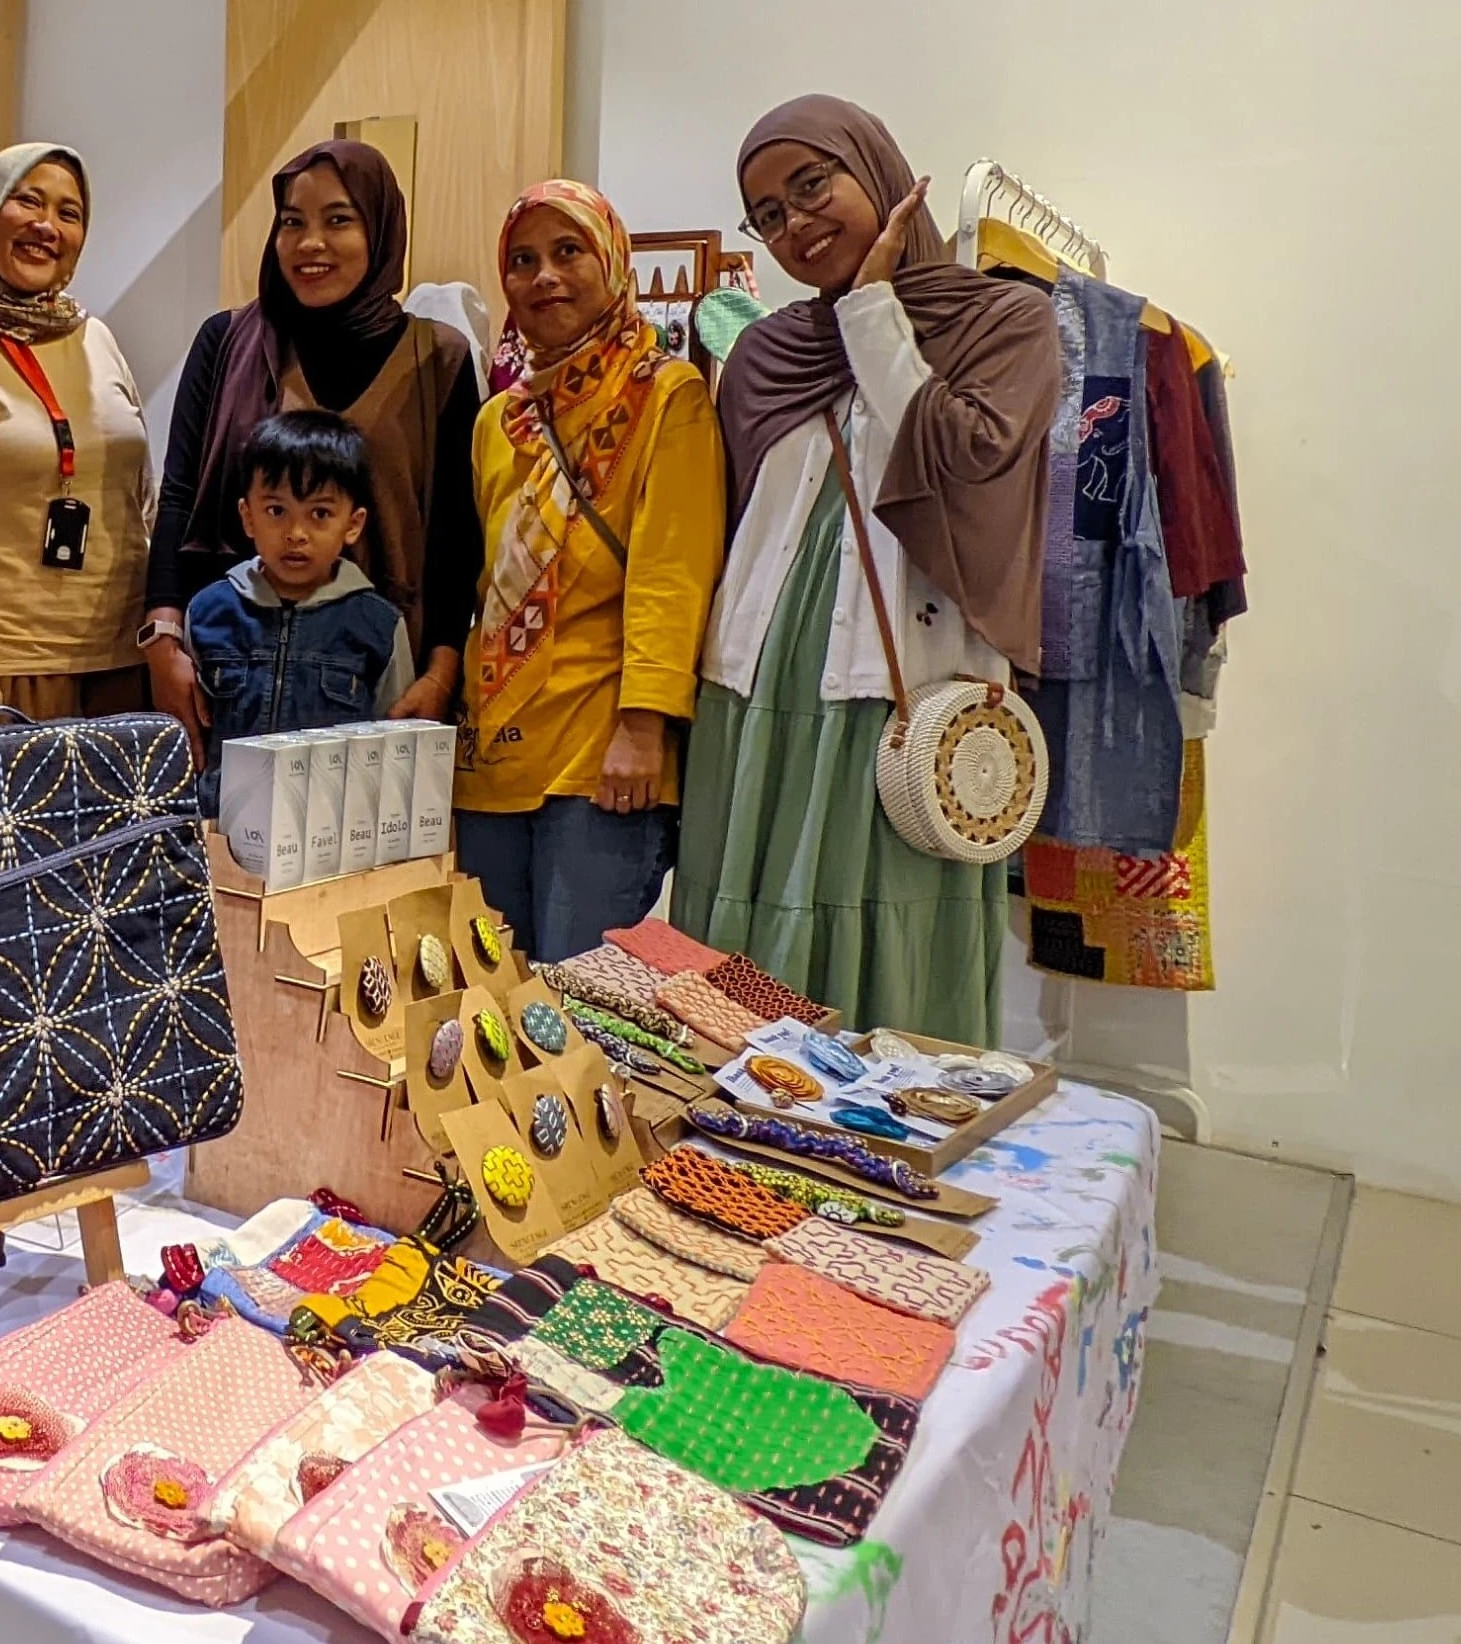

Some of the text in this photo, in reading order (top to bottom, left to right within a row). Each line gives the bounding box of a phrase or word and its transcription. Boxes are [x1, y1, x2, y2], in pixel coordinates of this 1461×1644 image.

[419, 816, 442, 828] Beau
[350, 828, 372, 842] Beau
[276, 842, 299, 857] Beau
